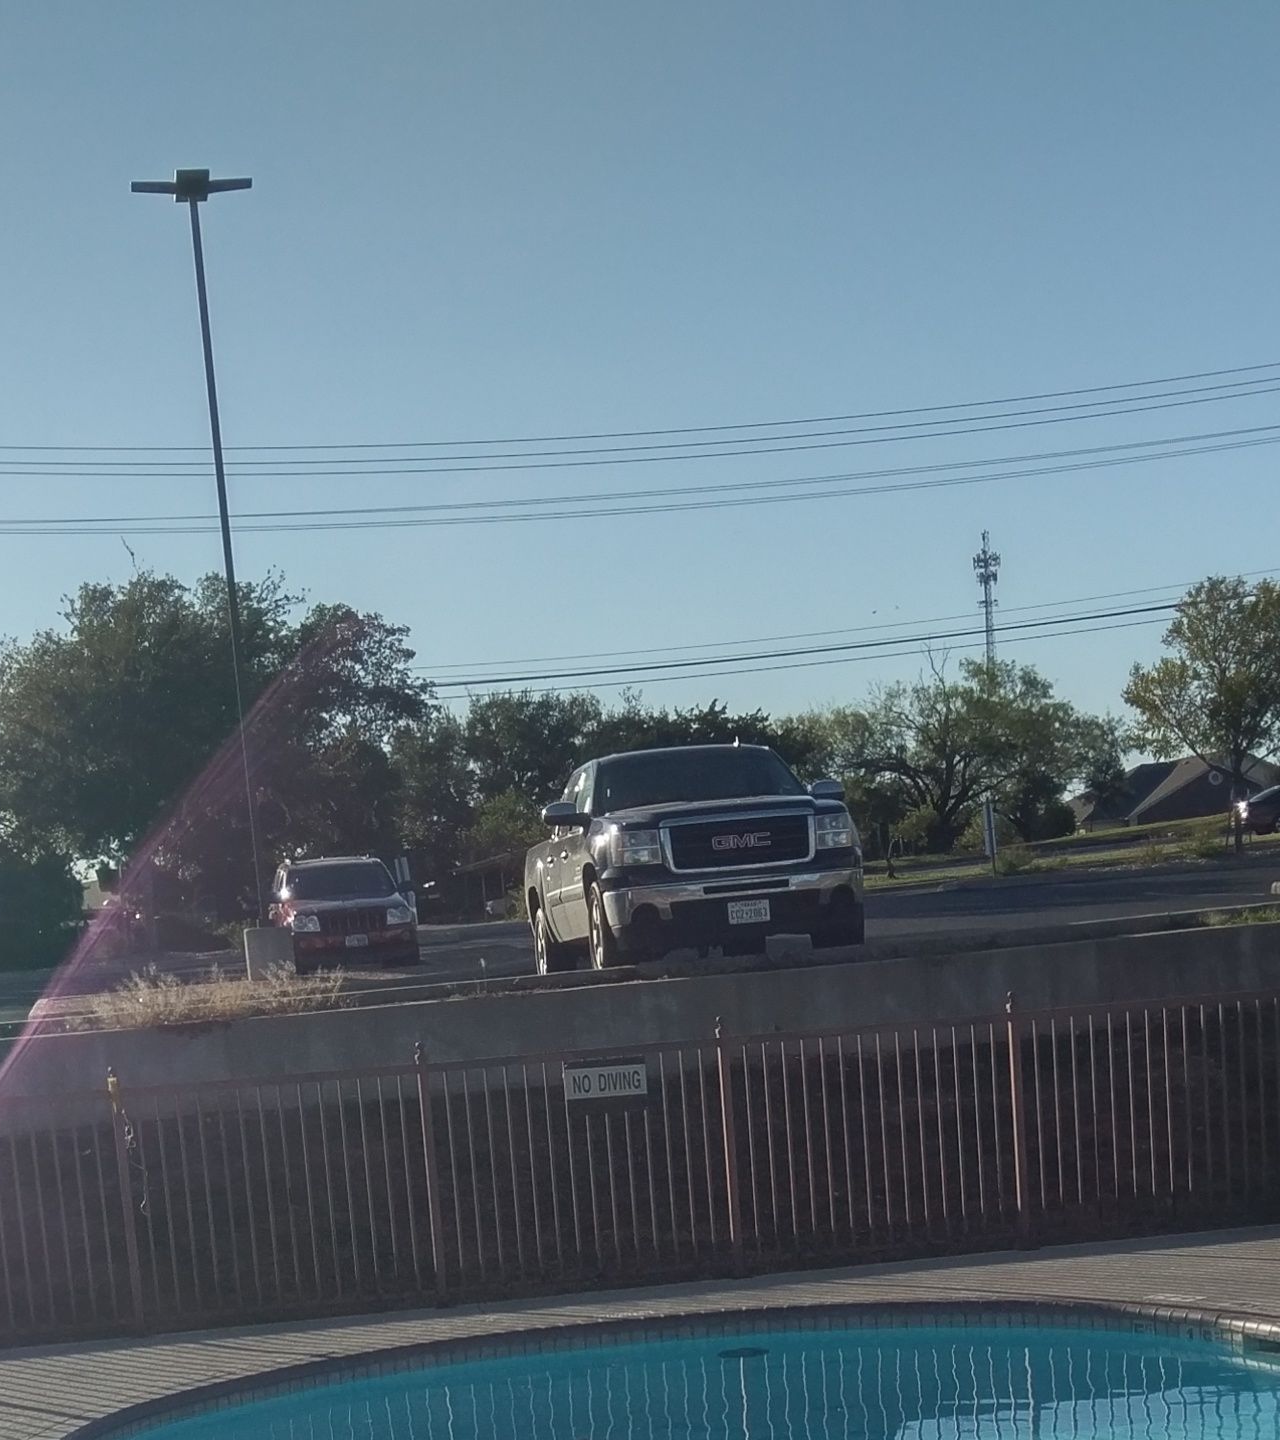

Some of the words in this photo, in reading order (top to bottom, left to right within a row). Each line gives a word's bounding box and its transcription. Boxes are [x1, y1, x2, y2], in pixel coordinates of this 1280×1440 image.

[712, 832, 771, 850] GMC
[572, 1074, 592, 1094] NO
[598, 1070, 641, 1092] DIVING
